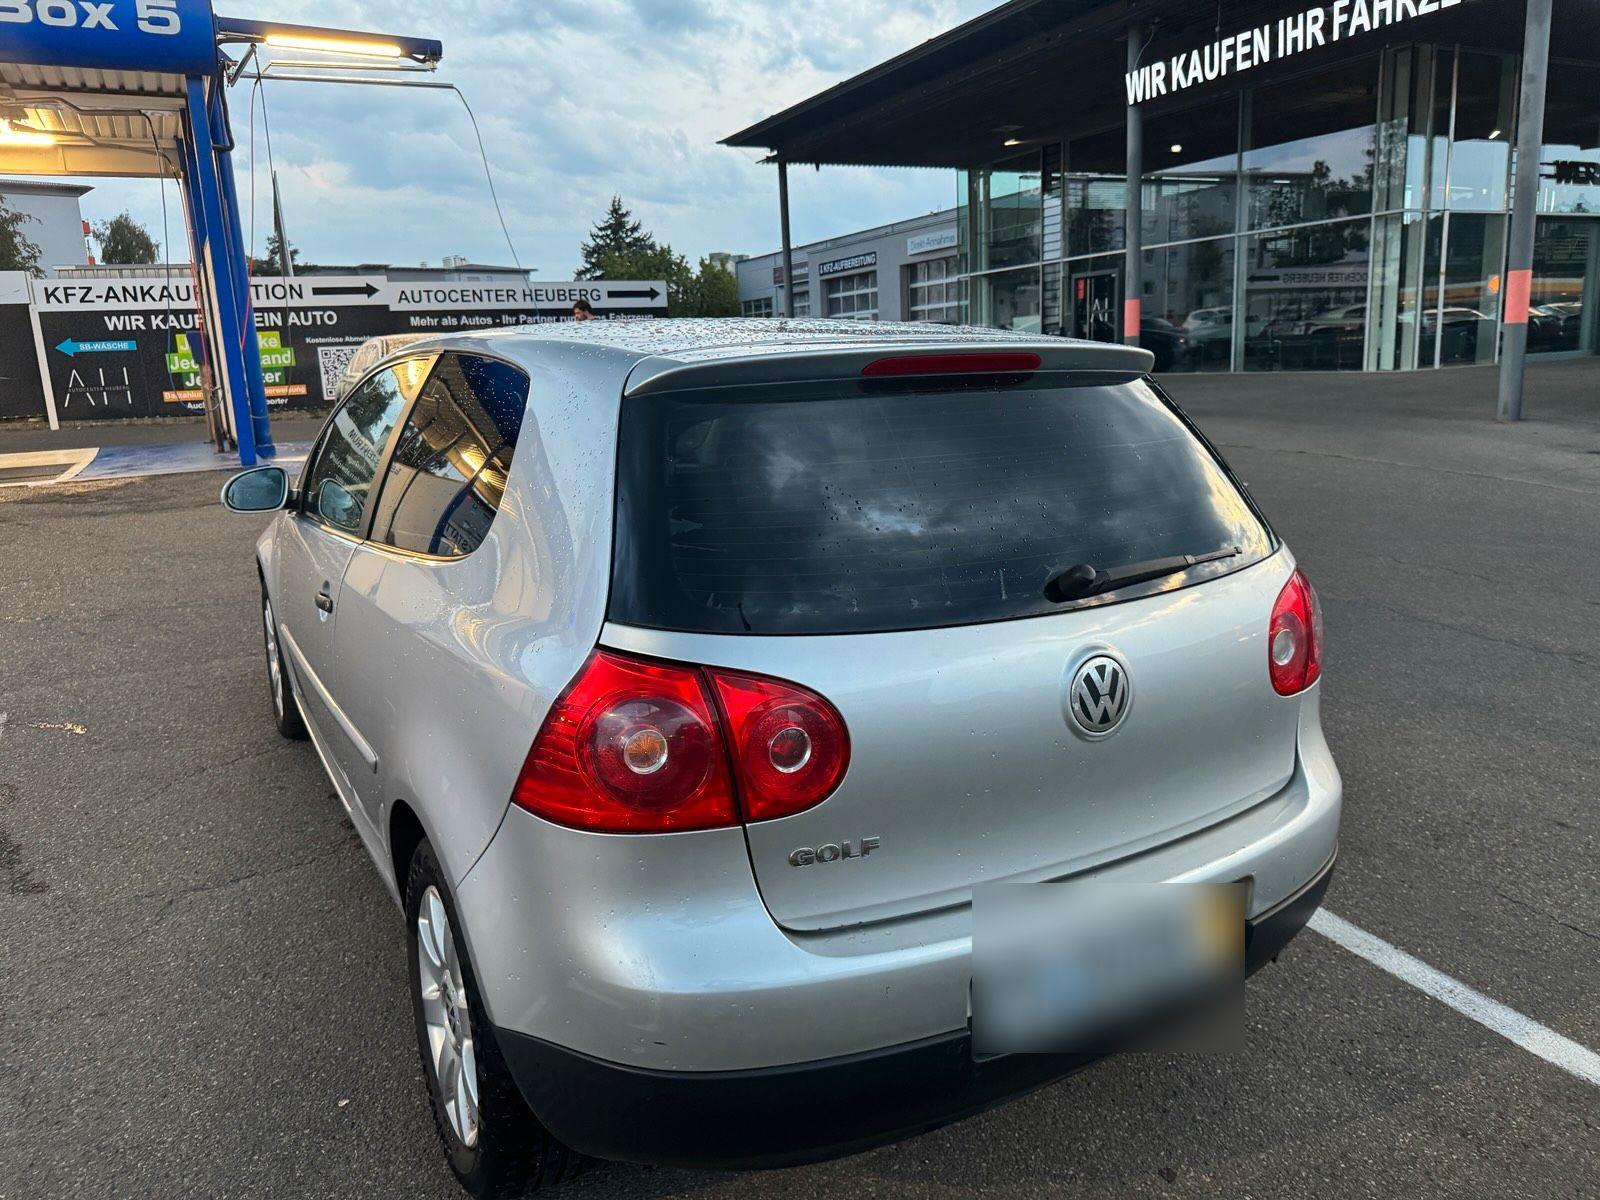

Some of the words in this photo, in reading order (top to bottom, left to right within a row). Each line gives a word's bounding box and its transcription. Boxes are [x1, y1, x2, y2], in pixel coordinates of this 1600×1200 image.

[136, 0, 181, 35] 5
[1125, 62, 1167, 106] WIR
[1171, 25, 1270, 92] KAUFEN
[1278, 7, 1326, 58] IHR
[1332, 0, 1461, 41] FAHR
[44, 285, 200, 304] KFZ-ANKAU
[250, 284, 304, 300] TION
[398, 289, 517, 304] AUTOCENTER
[522, 288, 602, 302] HEUBERG
[104, 316, 146, 331] WIR
[151, 314, 203, 329] KAUF
[253, 312, 282, 326] EIN
[288, 311, 338, 326] AUTO
[410, 317, 439, 327] Mehr
[441, 316, 458, 326] als
[460, 315, 493, 325] Autos
[502, 314, 517, 325] Ihr
[519, 314, 556, 325] Partner
[164, 391, 204, 400] Barzahlun
[788, 836, 880, 868] GOLF
